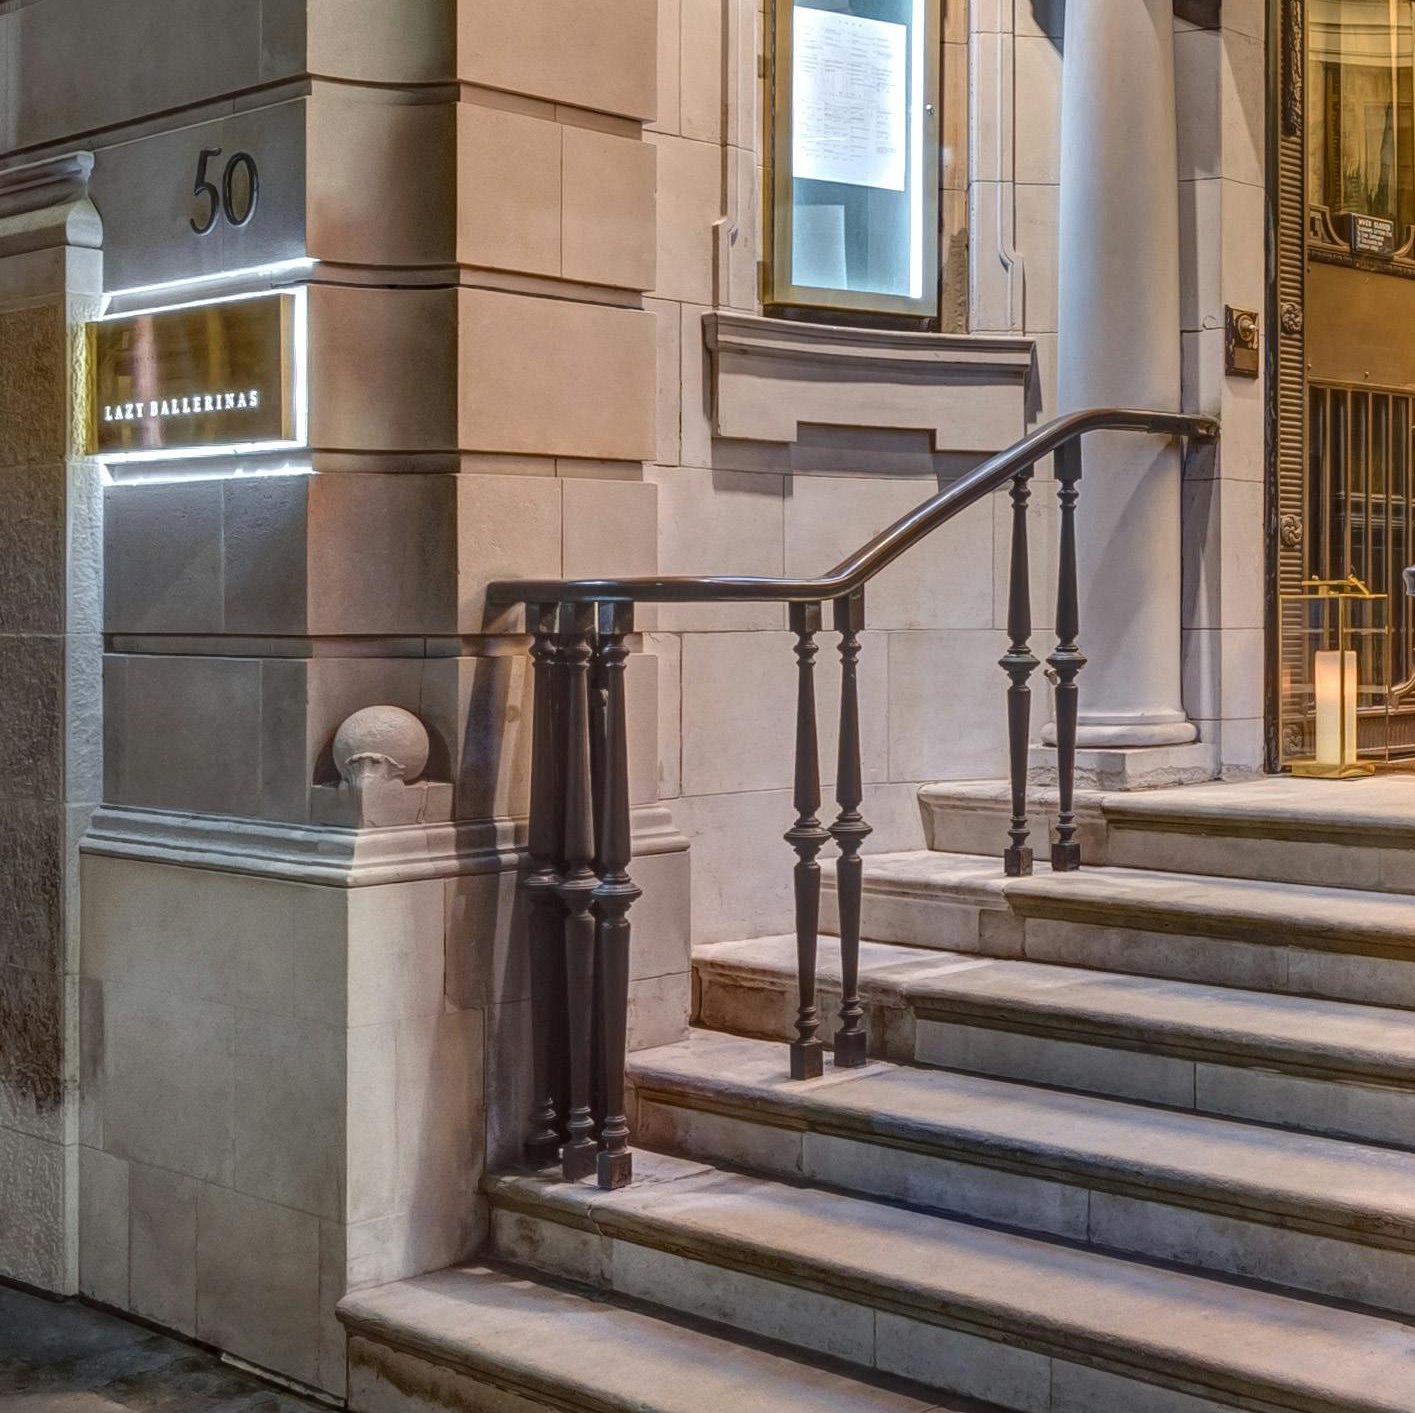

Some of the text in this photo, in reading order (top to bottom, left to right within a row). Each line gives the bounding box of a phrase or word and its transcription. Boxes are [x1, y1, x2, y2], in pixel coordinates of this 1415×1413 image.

[190, 146, 260, 237] 50
[104, 389, 260, 421] LAZY BALLERINAS
